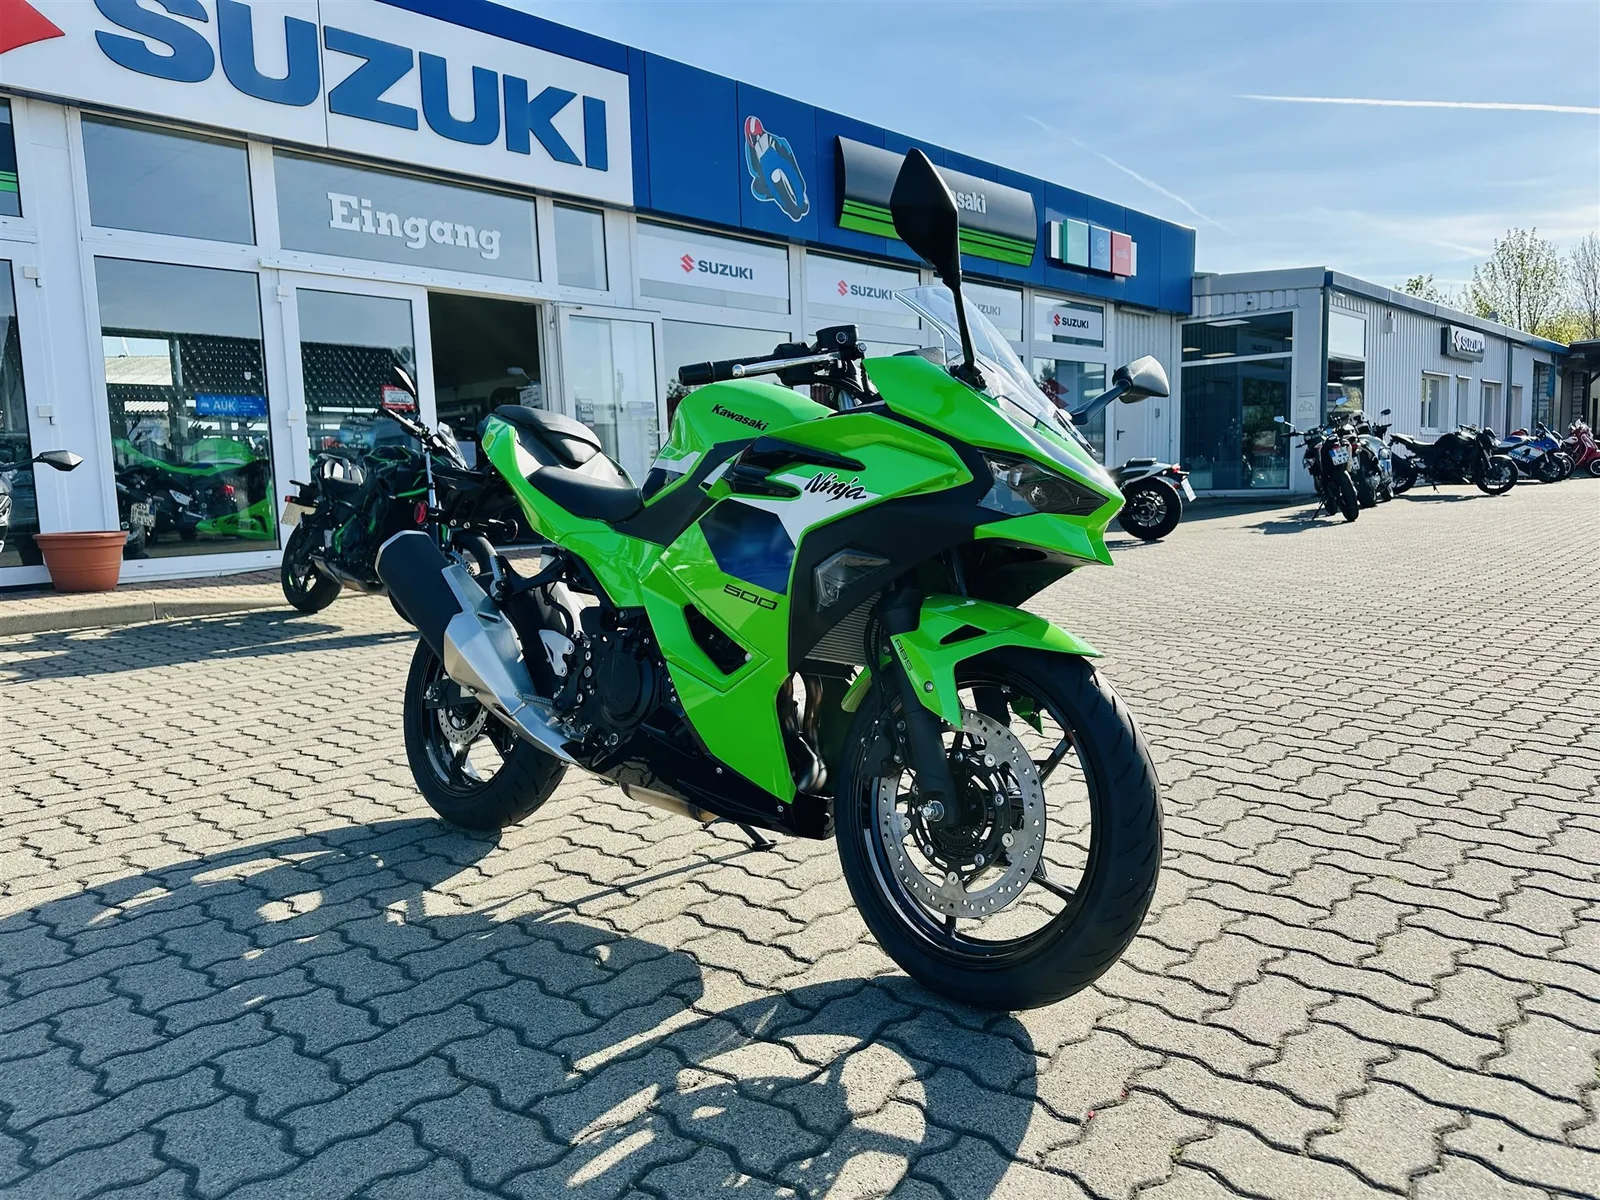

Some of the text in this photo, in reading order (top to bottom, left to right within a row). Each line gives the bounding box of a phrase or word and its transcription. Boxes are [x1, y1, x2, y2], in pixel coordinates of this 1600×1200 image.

[94, 0, 608, 172] SUZUKI
[327, 191, 501, 260] Eingang
[698, 260, 753, 280] SUZUKI
[850, 284, 892, 300] SUZUKI
[1061, 317, 1089, 329] SUZUKI
[213, 400, 236, 411] AUK
[711, 404, 769, 431] Kawasaki
[804, 472, 867, 503] Ninja
[723, 583, 779, 611] 500
[895, 638, 914, 671] ABS
